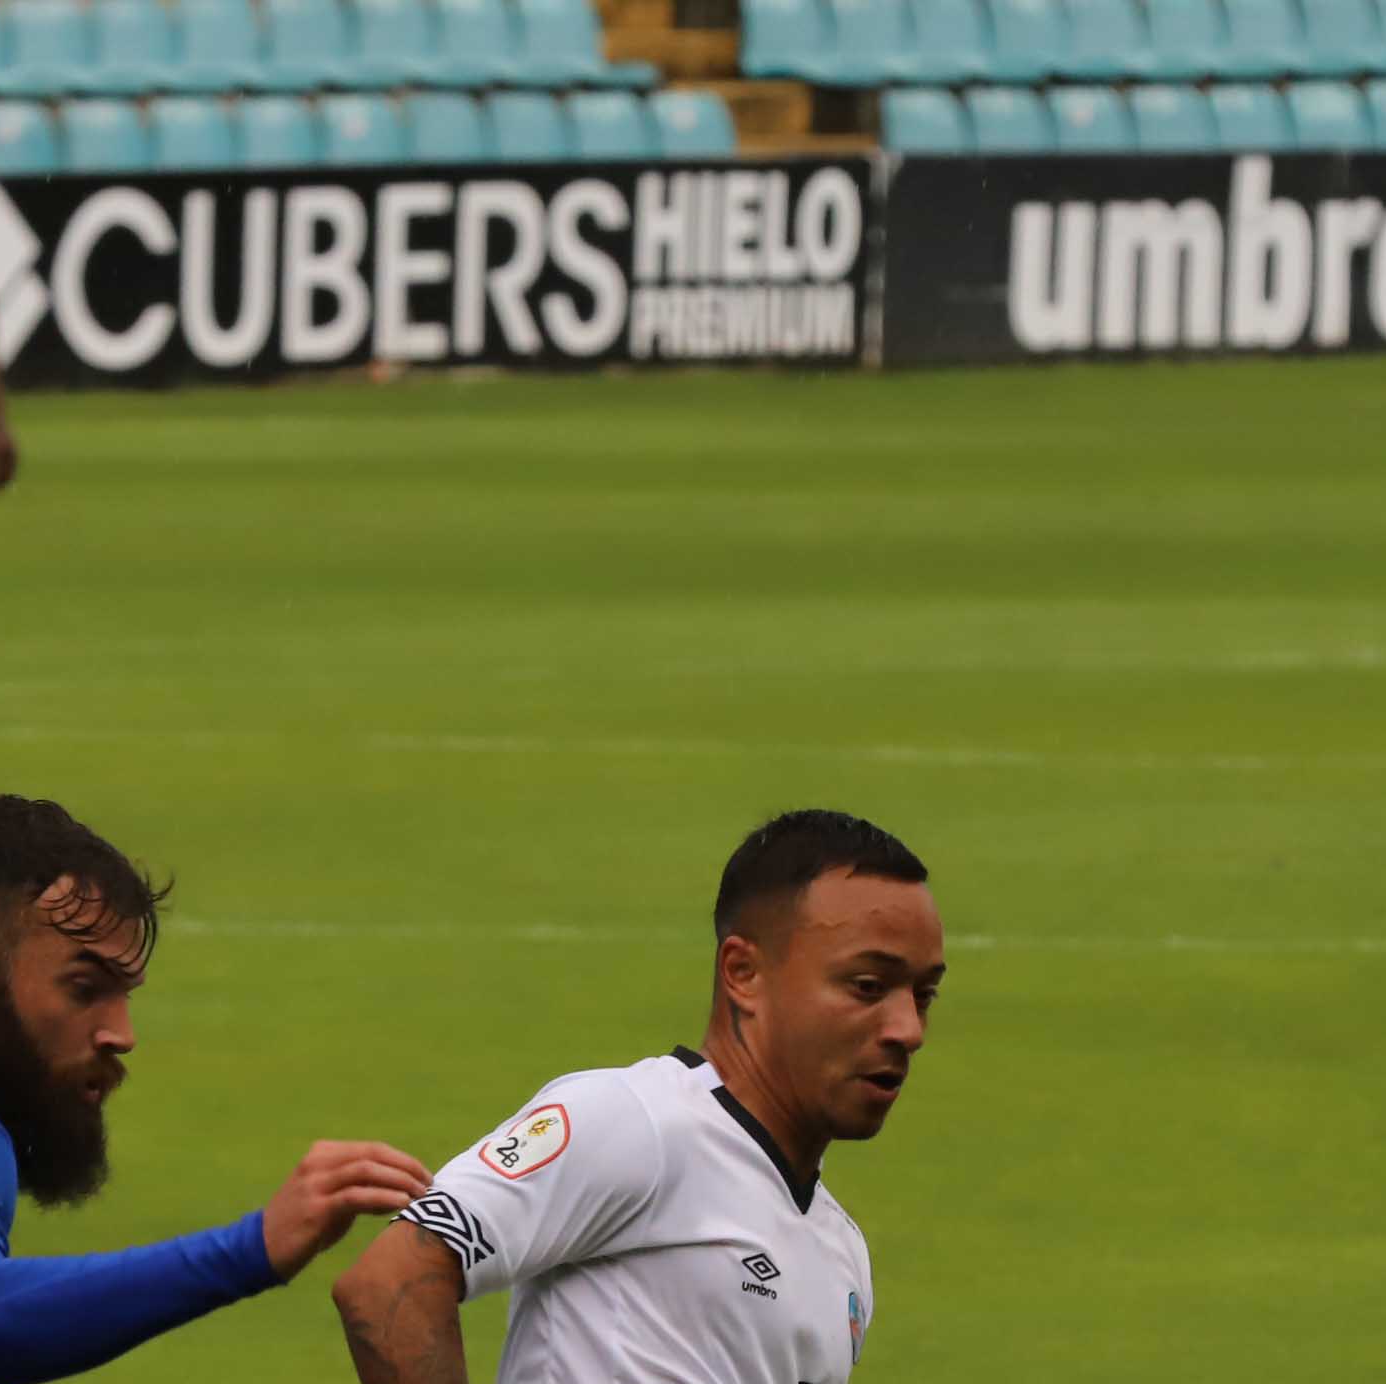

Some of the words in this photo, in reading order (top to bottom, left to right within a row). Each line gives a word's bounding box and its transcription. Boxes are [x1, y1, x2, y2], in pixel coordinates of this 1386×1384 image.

[634, 167, 860, 281] HIELO
[50, 179, 628, 371] CUBERS
[630, 283, 854, 359] PREMIUM
[742, 1282, 777, 1299] umbro
